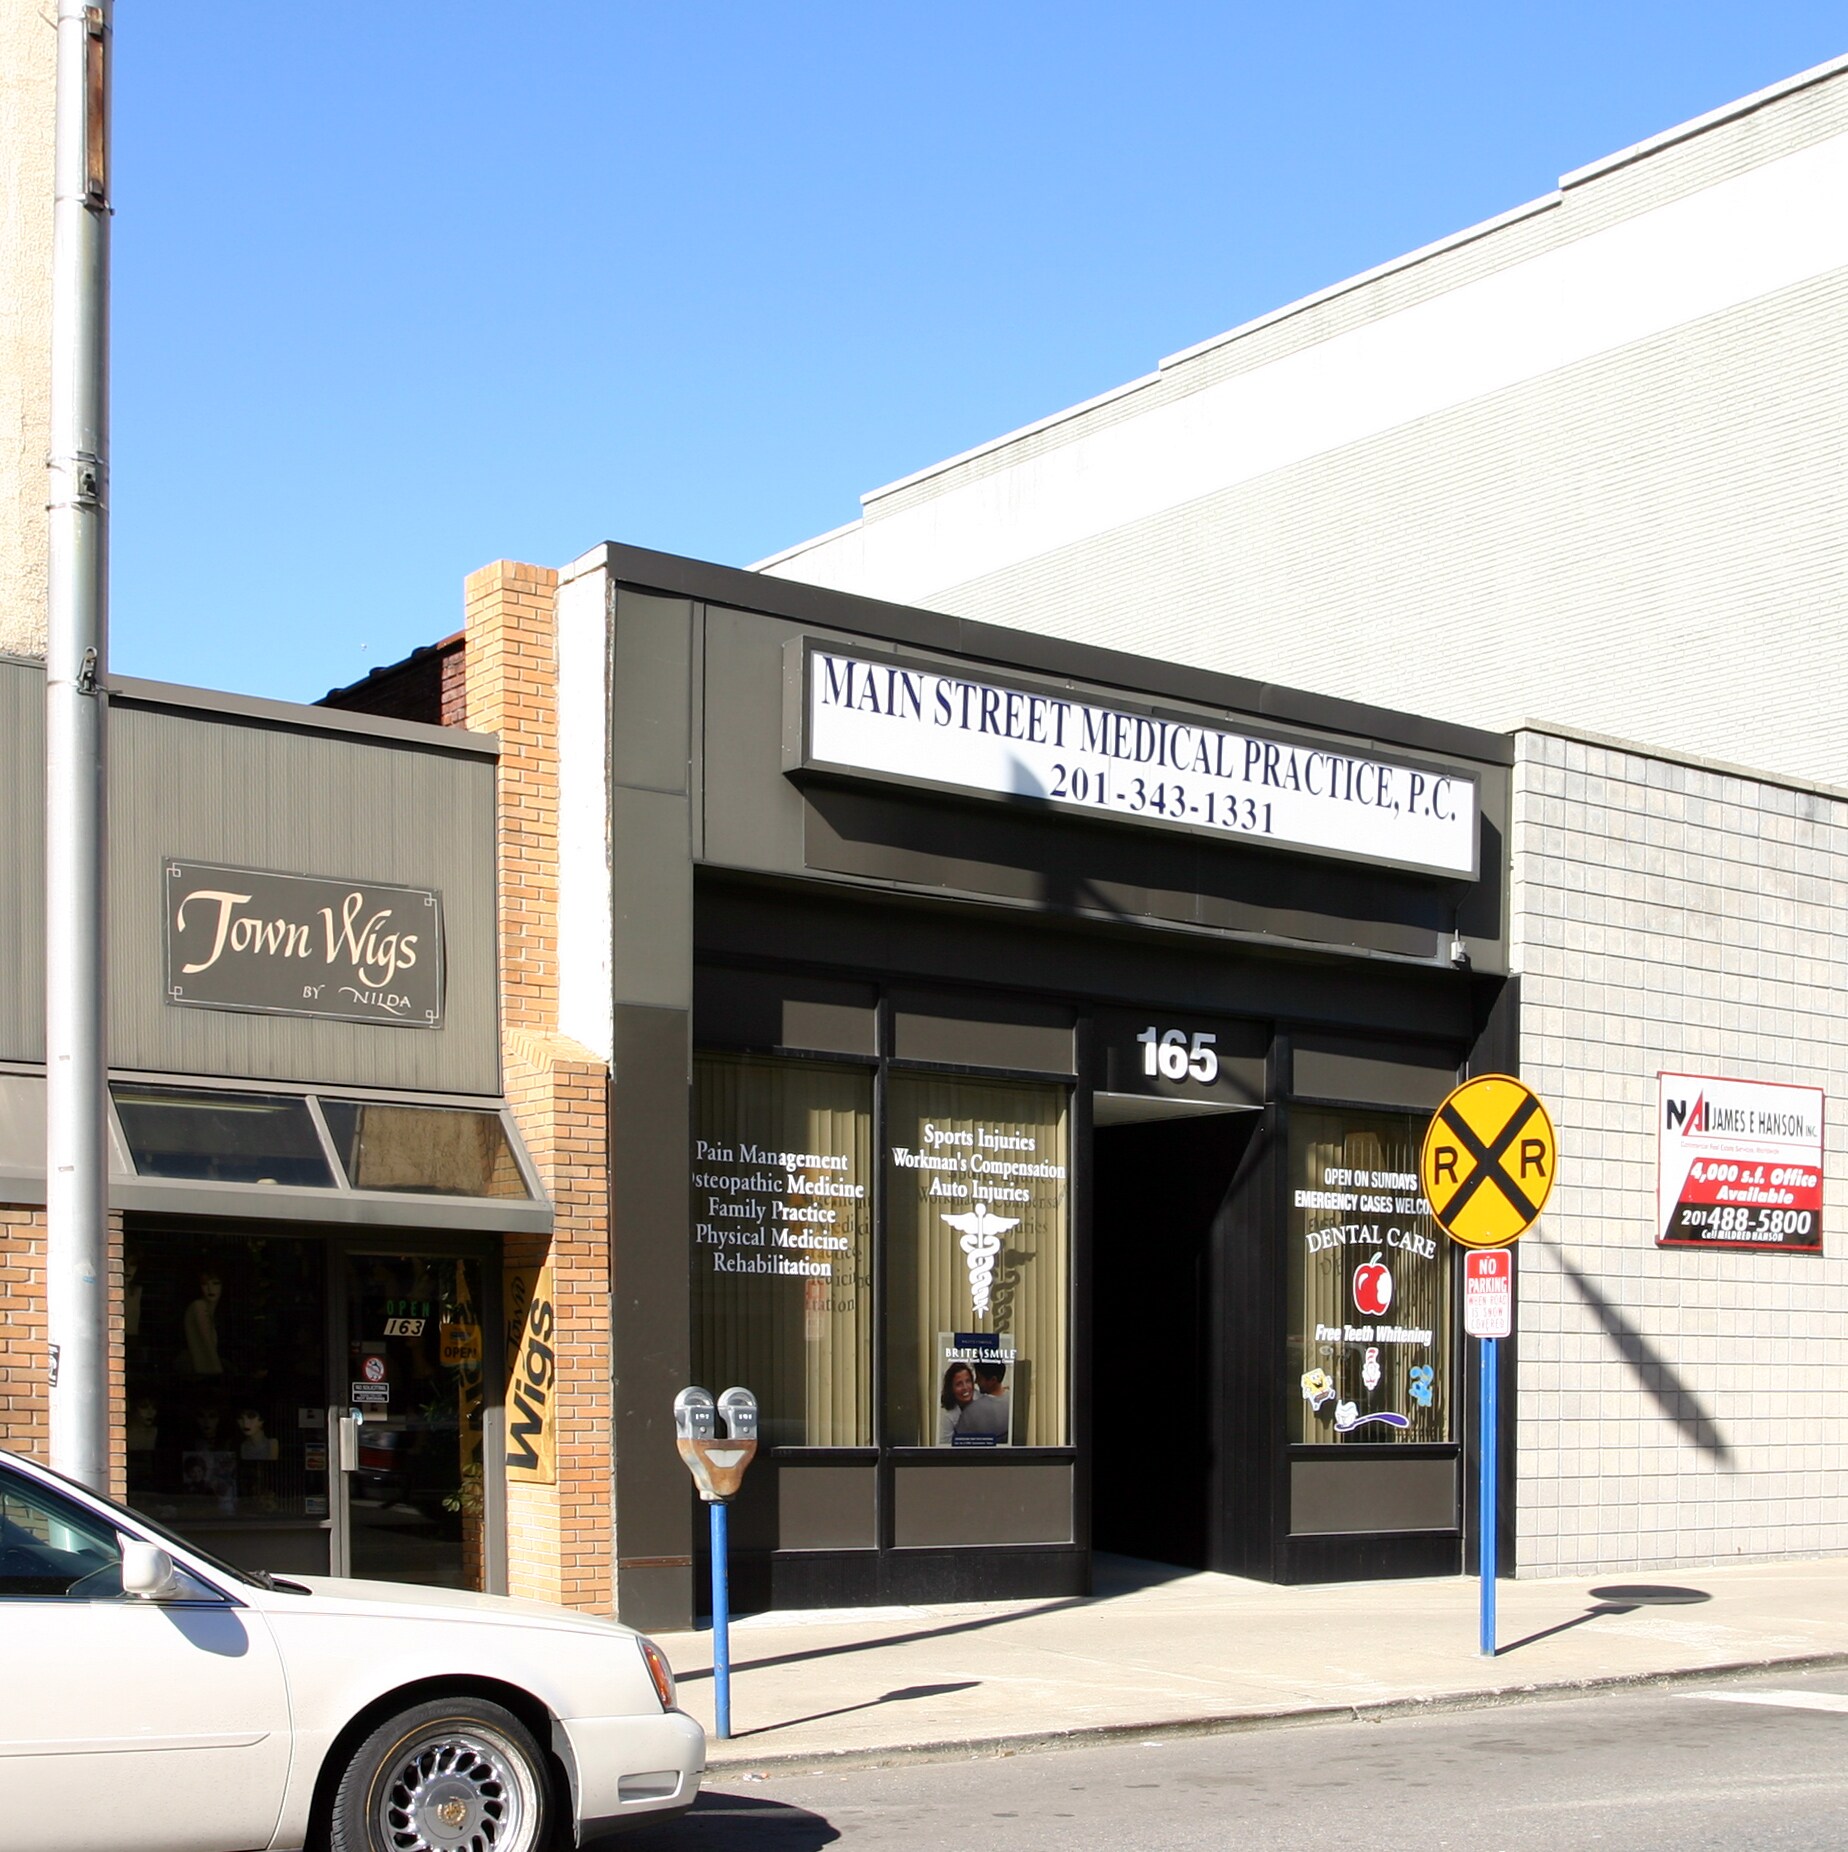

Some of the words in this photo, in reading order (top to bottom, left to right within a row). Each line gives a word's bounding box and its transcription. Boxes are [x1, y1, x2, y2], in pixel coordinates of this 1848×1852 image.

[822, 656, 925, 720] MAIN
[933, 678, 1071, 747] STREET
[1080, 706, 1233, 779] MEDICAL
[1242, 738, 1401, 820] PRACTICE,
[1406, 773, 1457, 822] P.C.
[1049, 763, 1276, 835] 201-343-1331
[176, 890, 313, 974] Town
[317, 892, 418, 987] Wigs
[303, 985, 325, 999] BY
[338, 987, 412, 1015] NILDA
[1136, 1026, 1218, 1082] 165
[1667, 1088, 1710, 1136] NAI
[1712, 1107, 1746, 1133] JAMES
[1758, 1112, 1804, 1138] HANSON
[924, 1123, 973, 1148] Sports
[978, 1128, 1035, 1152] Injuries
[696, 1140, 733, 1162] Pain
[739, 1143, 848, 1172] Management
[892, 1147, 967, 1171] Workman's
[970, 1154, 1066, 1180] Compensation
[1434, 1146, 1459, 1185] R
[1520, 1139, 1546, 1179] R
[692, 1171, 783, 1196] steopathic
[786, 1174, 864, 1198] Medicine
[1324, 1168, 1352, 1186] OPEN
[1354, 1170, 1369, 1187] ON
[1370, 1171, 1417, 1191] SUNDAYS
[1690, 1161, 1739, 1183] 4,000
[1740, 1166, 1765, 1184] s.f.
[1770, 1168, 1817, 1188] Office
[929, 1176, 967, 1197] Auto
[972, 1179, 1030, 1203] Injuries
[1294, 1190, 1359, 1211] EMERGENCY
[1360, 1194, 1393, 1213] CASES
[1395, 1197, 1432, 1215] WELCO
[1716, 1185, 1794, 1204] Available
[708, 1196, 766, 1224] Family
[772, 1200, 836, 1223] Practice
[1681, 1209, 1707, 1226] 201
[1706, 1206, 1812, 1234] 488-5800
[696, 1223, 765, 1249] Physical
[771, 1227, 848, 1250] Medicine
[1305, 1224, 1383, 1253] DENTAL
[1387, 1228, 1437, 1259] CARE
[1717, 1229, 1751, 1241] MILDRED
[1752, 1231, 1784, 1242] HANSON
[713, 1251, 831, 1276] Rehabilitation
[1479, 1258, 1497, 1275] NO
[1468, 1276, 1508, 1294] PARKING
[386, 1301, 430, 1317] OPEN
[389, 1319, 422, 1334] 163
[1315, 1324, 1341, 1341] Free
[1343, 1325, 1374, 1342] Teeth
[1376, 1326, 1432, 1346] Whitening
[444, 1346, 477, 1358] OPEN
[945, 1347, 978, 1358] BRITE
[984, 1348, 1015, 1359] SMILE
[507, 1298, 555, 1470] Wigs
